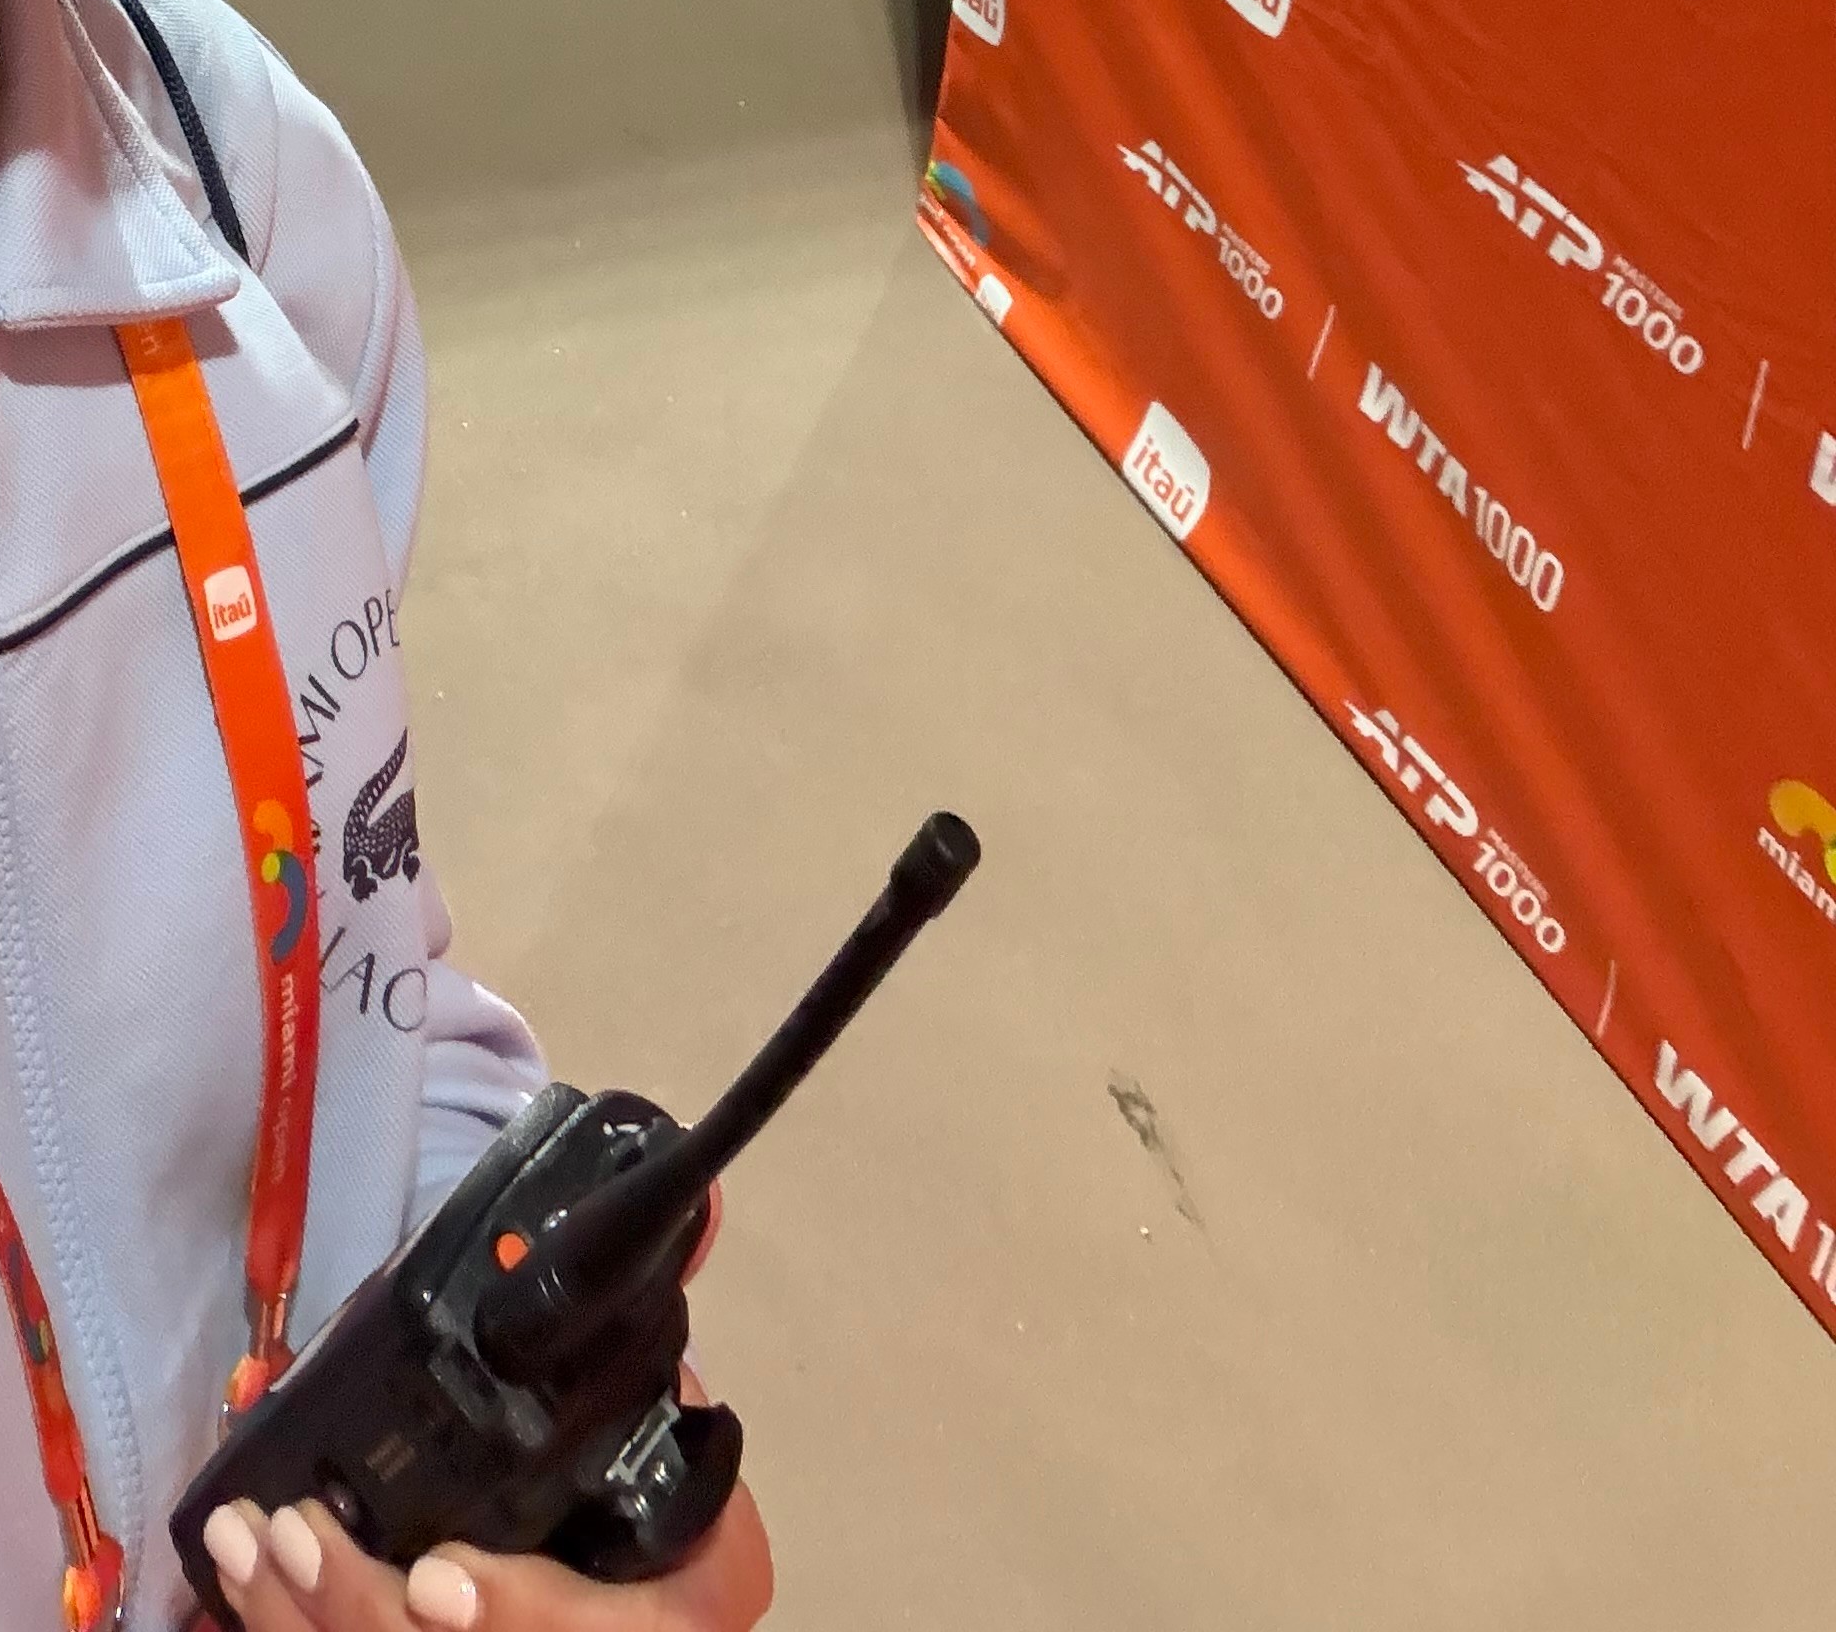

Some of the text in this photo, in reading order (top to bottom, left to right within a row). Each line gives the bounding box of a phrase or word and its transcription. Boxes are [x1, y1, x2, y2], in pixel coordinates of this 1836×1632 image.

[1455, 153, 1605, 272] ATP
[1601, 271, 1705, 375] 1000
[1116, 138, 1218, 236] ATP
[1217, 236, 1285, 320] 1000
[1357, 360, 1469, 519] WTA
[1473, 485, 1565, 613] 1000
[1132, 434, 1196, 523] itaú
[212, 593, 253, 630] itaú
[330, 587, 402, 681] OPE
[280, 972, 301, 1090] miami
[1343, 698, 1479, 838] ATP
[1472, 839, 1567, 954] 1000
[1653, 1038, 1811, 1254] WTA
